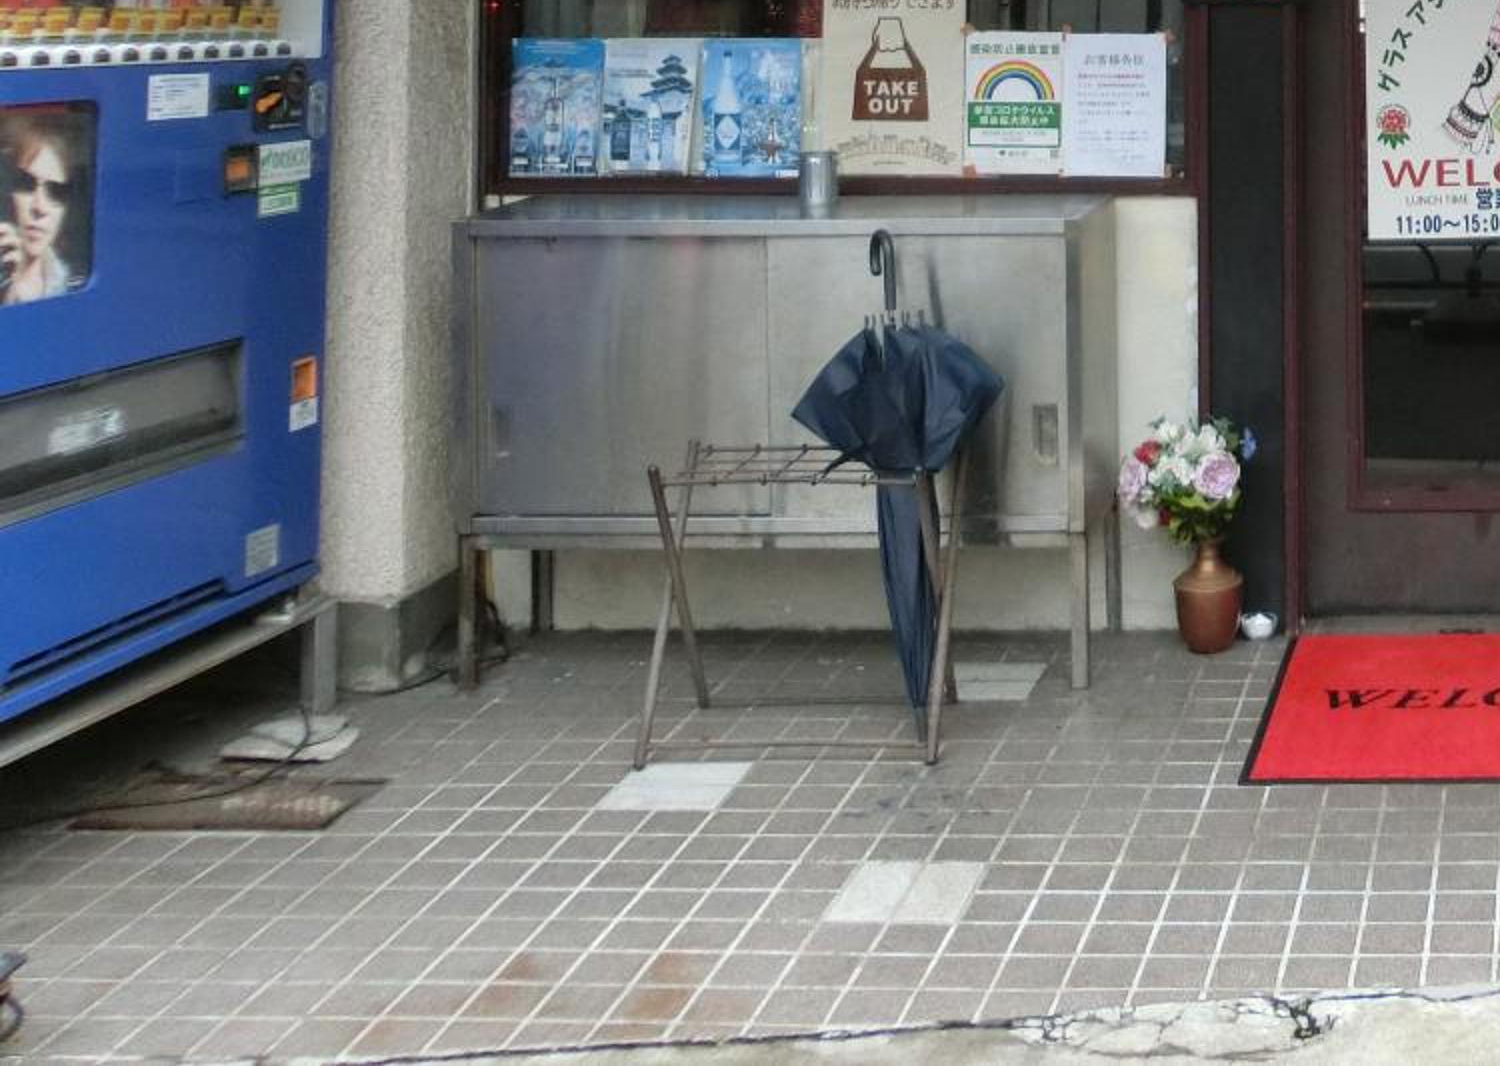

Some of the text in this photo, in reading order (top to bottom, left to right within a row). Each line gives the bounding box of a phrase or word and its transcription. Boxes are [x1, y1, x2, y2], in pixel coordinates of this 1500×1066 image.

[1377, 27, 1413, 92] グラス
[863, 79, 919, 96] TAKE
[868, 97, 913, 114] OUT
[1405, 194, 1443, 208] LUNCH
[1445, 194, 1469, 206] TIME
